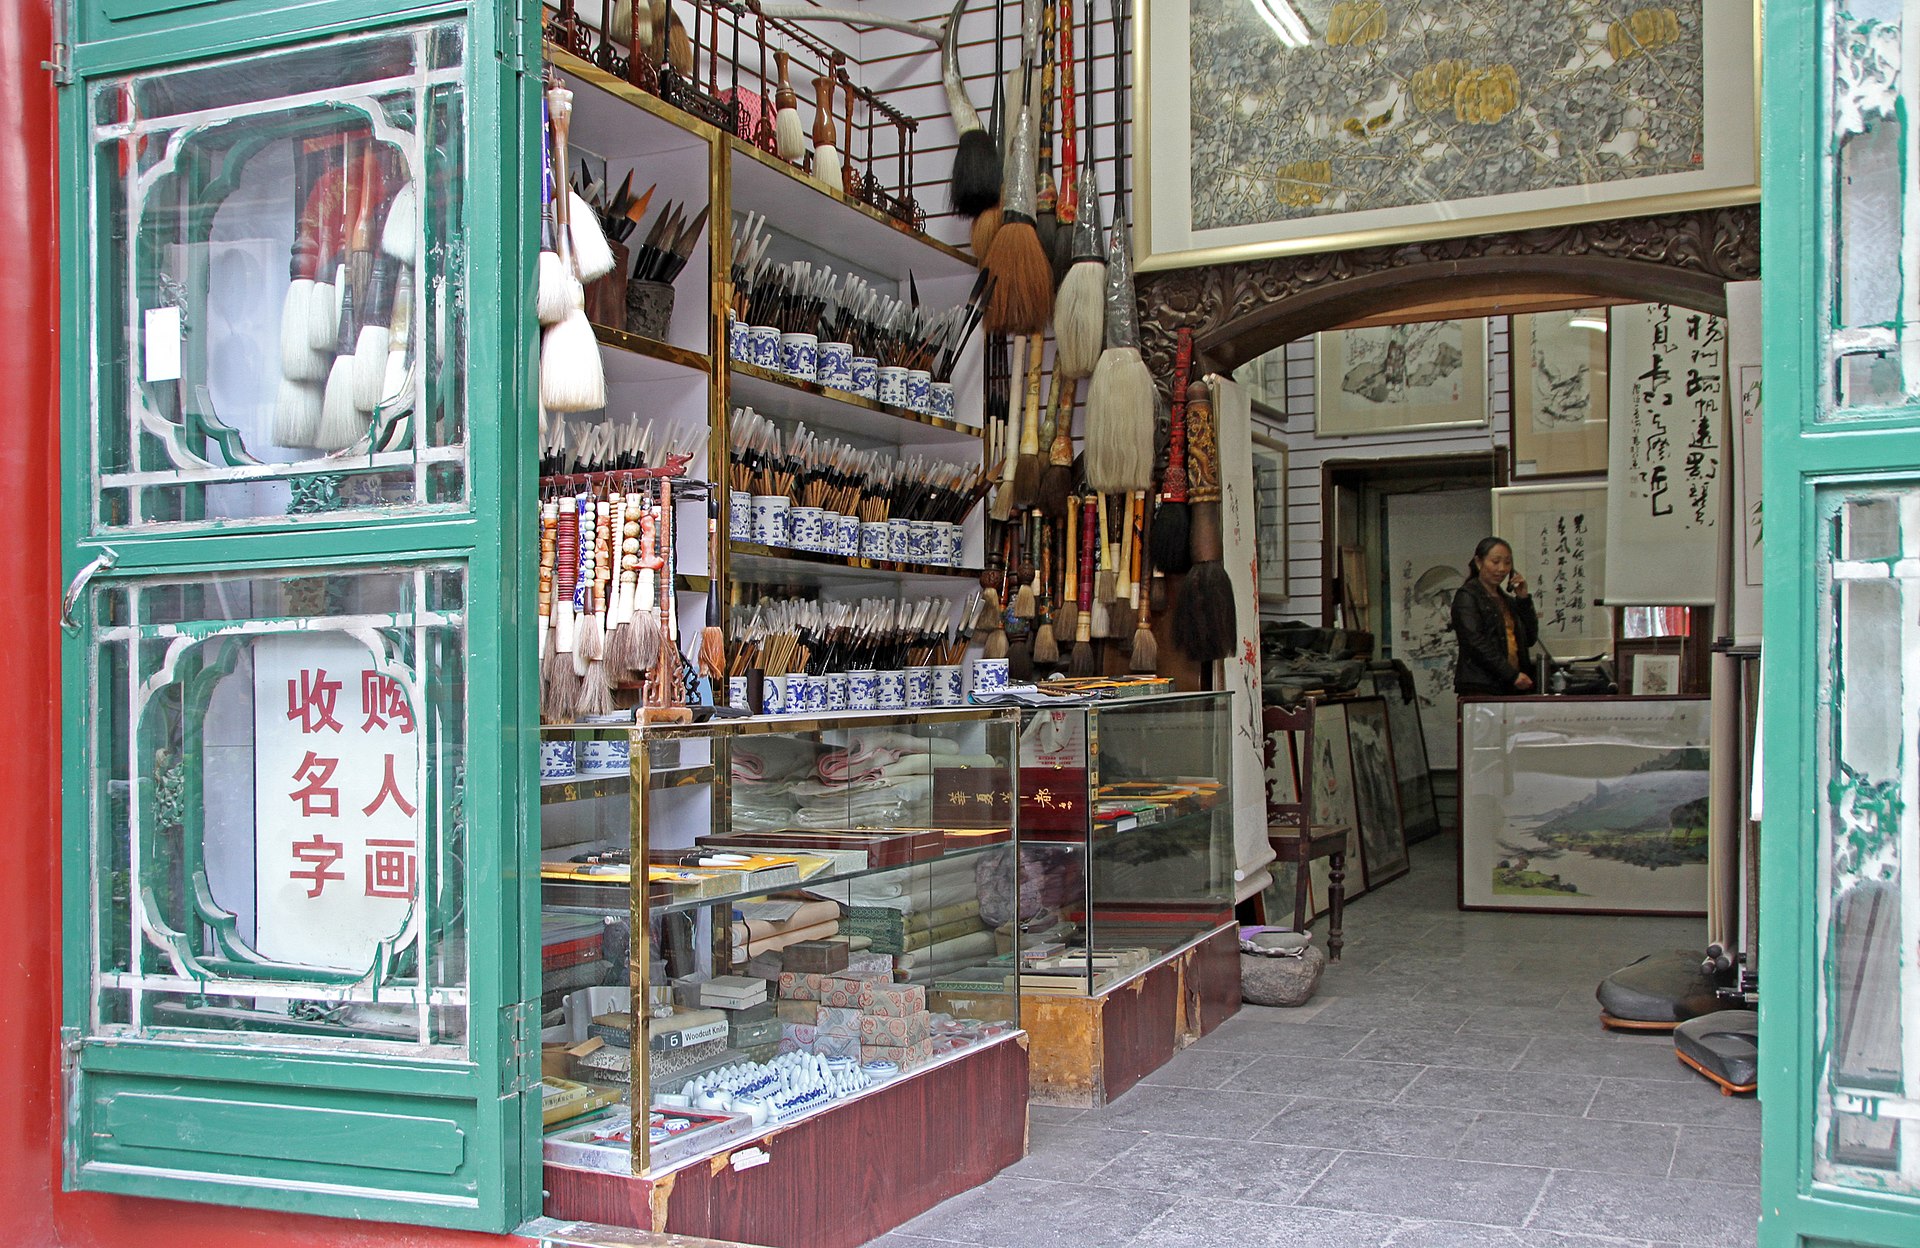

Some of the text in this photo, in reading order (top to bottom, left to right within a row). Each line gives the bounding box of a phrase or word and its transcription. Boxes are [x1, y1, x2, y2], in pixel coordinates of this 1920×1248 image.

[287, 669, 415, 734] 收购
[288, 751, 417, 818] 名人
[290, 834, 417, 903] 字画
[670, 1034, 679, 1047] 6
[684, 1024, 727, 1041] Woodcut Knife
